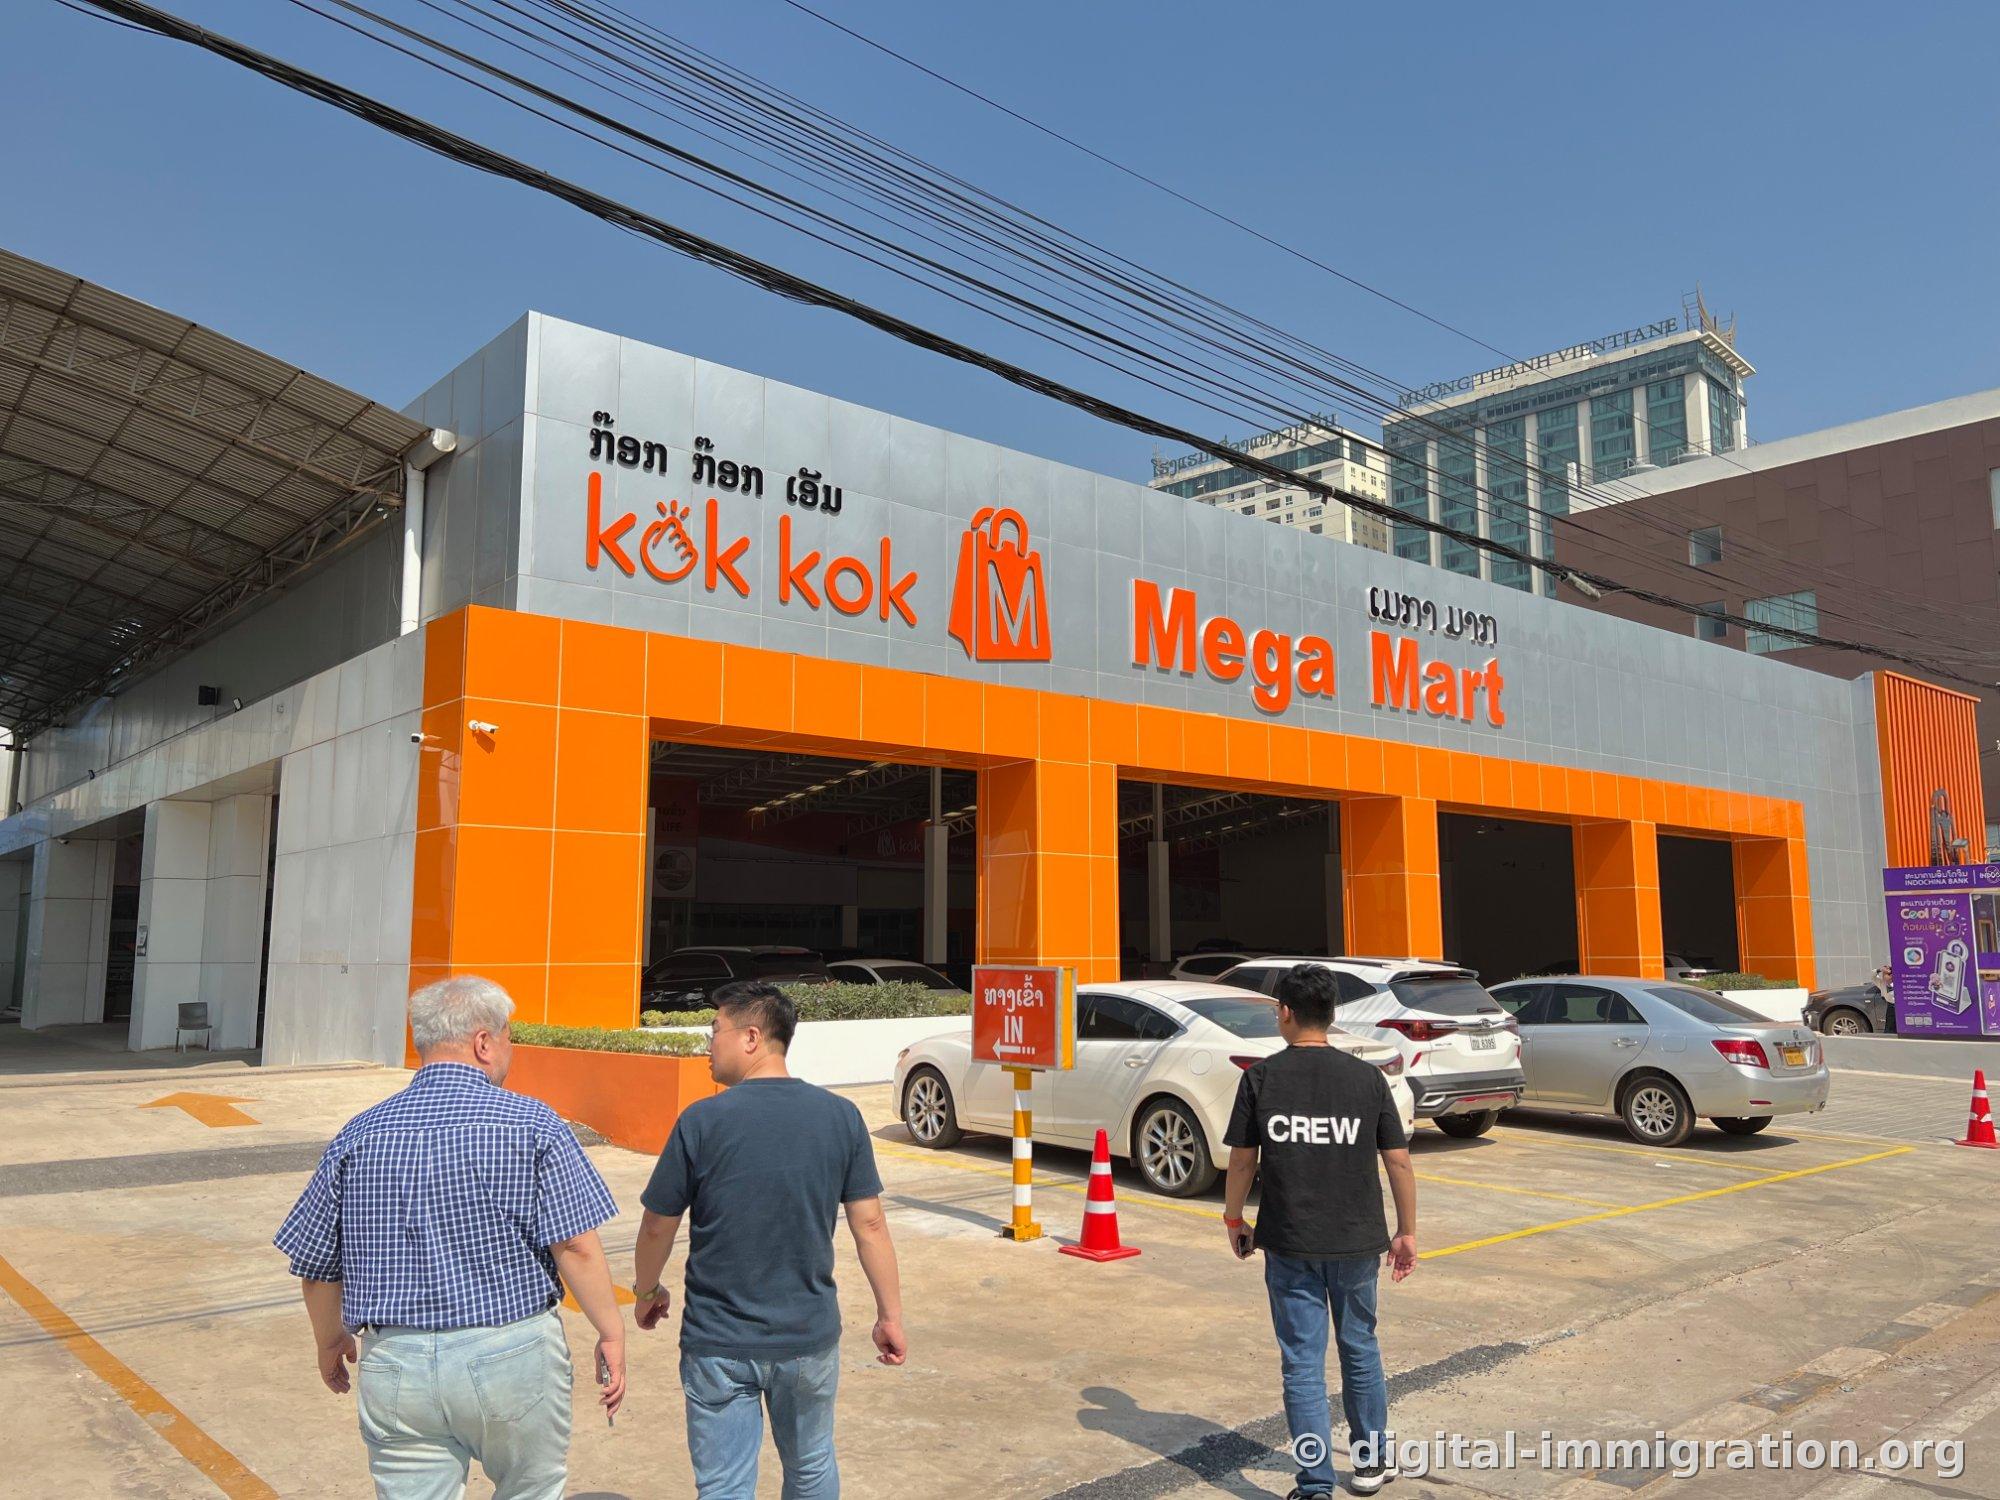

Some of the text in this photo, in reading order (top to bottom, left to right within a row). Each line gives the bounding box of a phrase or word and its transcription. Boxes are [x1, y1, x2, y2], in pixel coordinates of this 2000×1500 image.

[1474, 354, 1551, 384] THANH
[1556, 317, 1679, 363] VIENTIANE
[586, 471, 750, 597] kok
[779, 514, 918, 627] kok
[1131, 578, 1337, 715] Mega
[1368, 629, 1506, 727] Mart
[1904, 877, 1969, 886] INDOCHINA BANK
[1900, 907, 1957, 921] Cool Pay
[1004, 1015, 1023, 1044] IN
[1267, 1114, 1361, 1145] CREW
